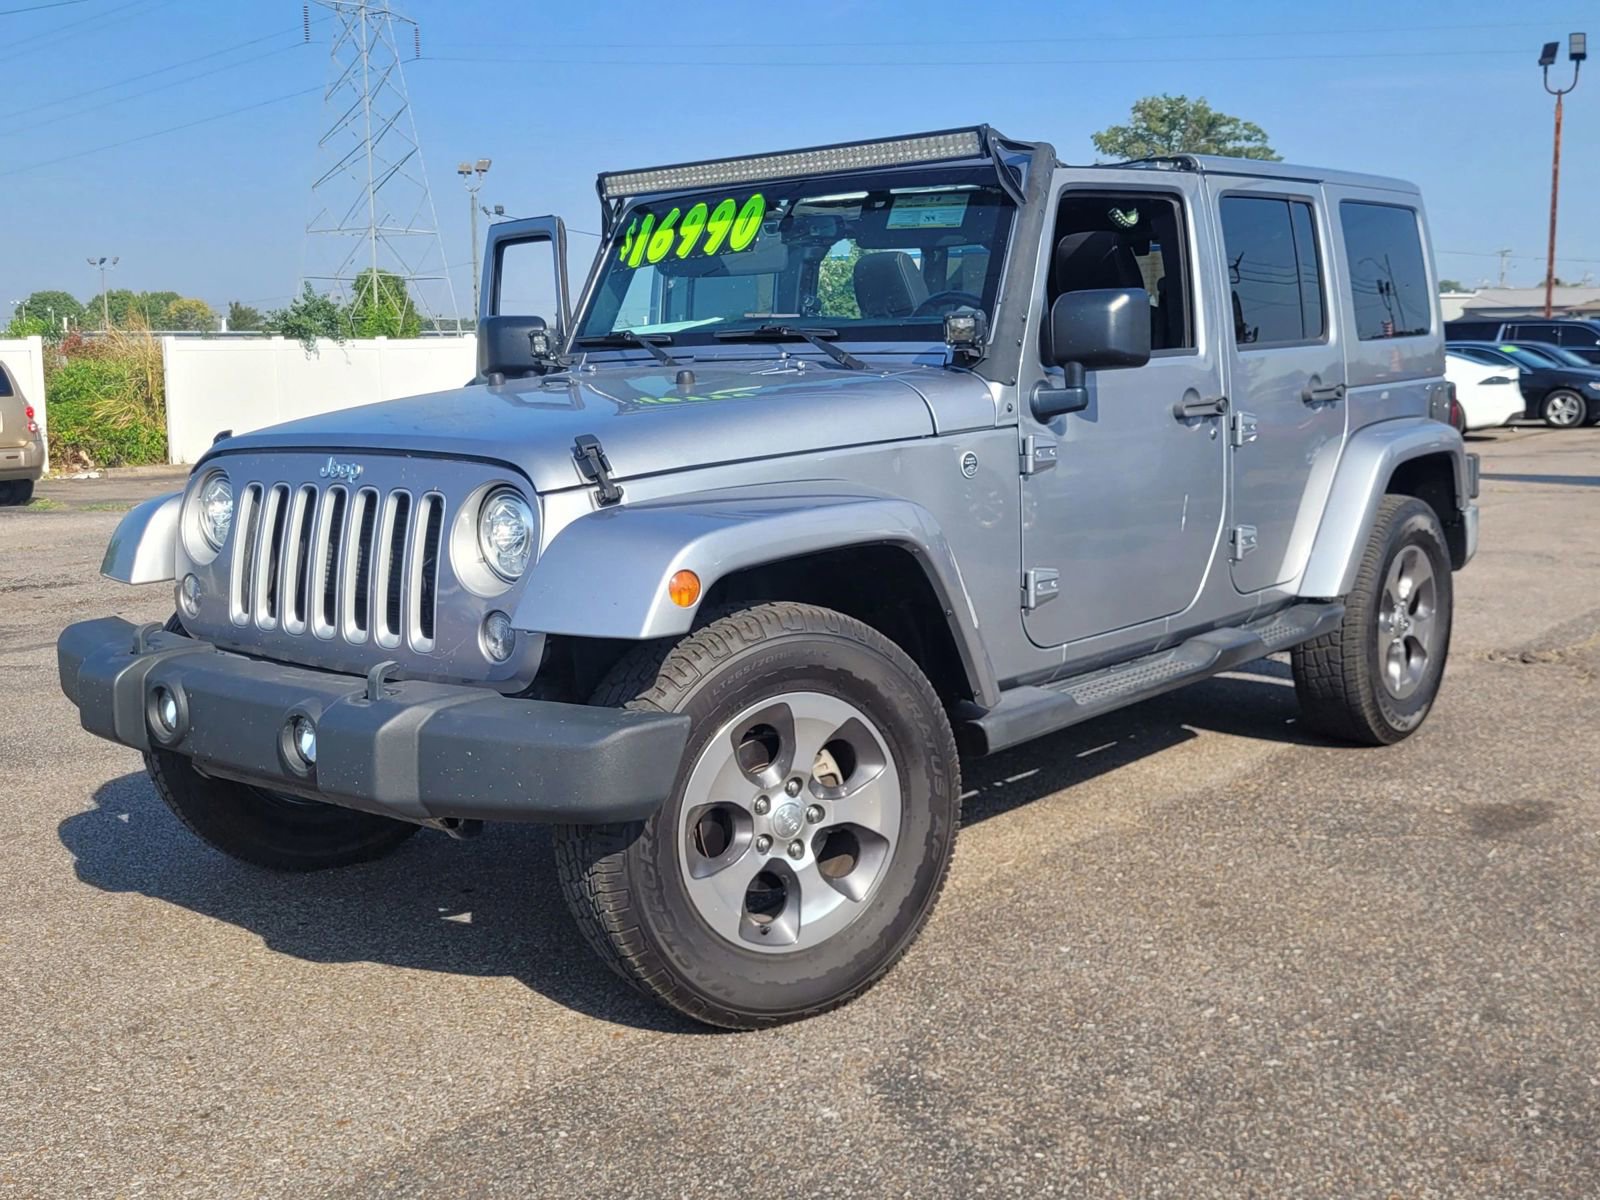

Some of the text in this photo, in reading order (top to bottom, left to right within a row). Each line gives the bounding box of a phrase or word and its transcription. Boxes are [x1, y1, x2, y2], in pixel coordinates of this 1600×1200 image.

[620, 194, 766, 268] $16990
[319, 456, 362, 484] Jeep
[881, 677, 946, 798] STRATUS
